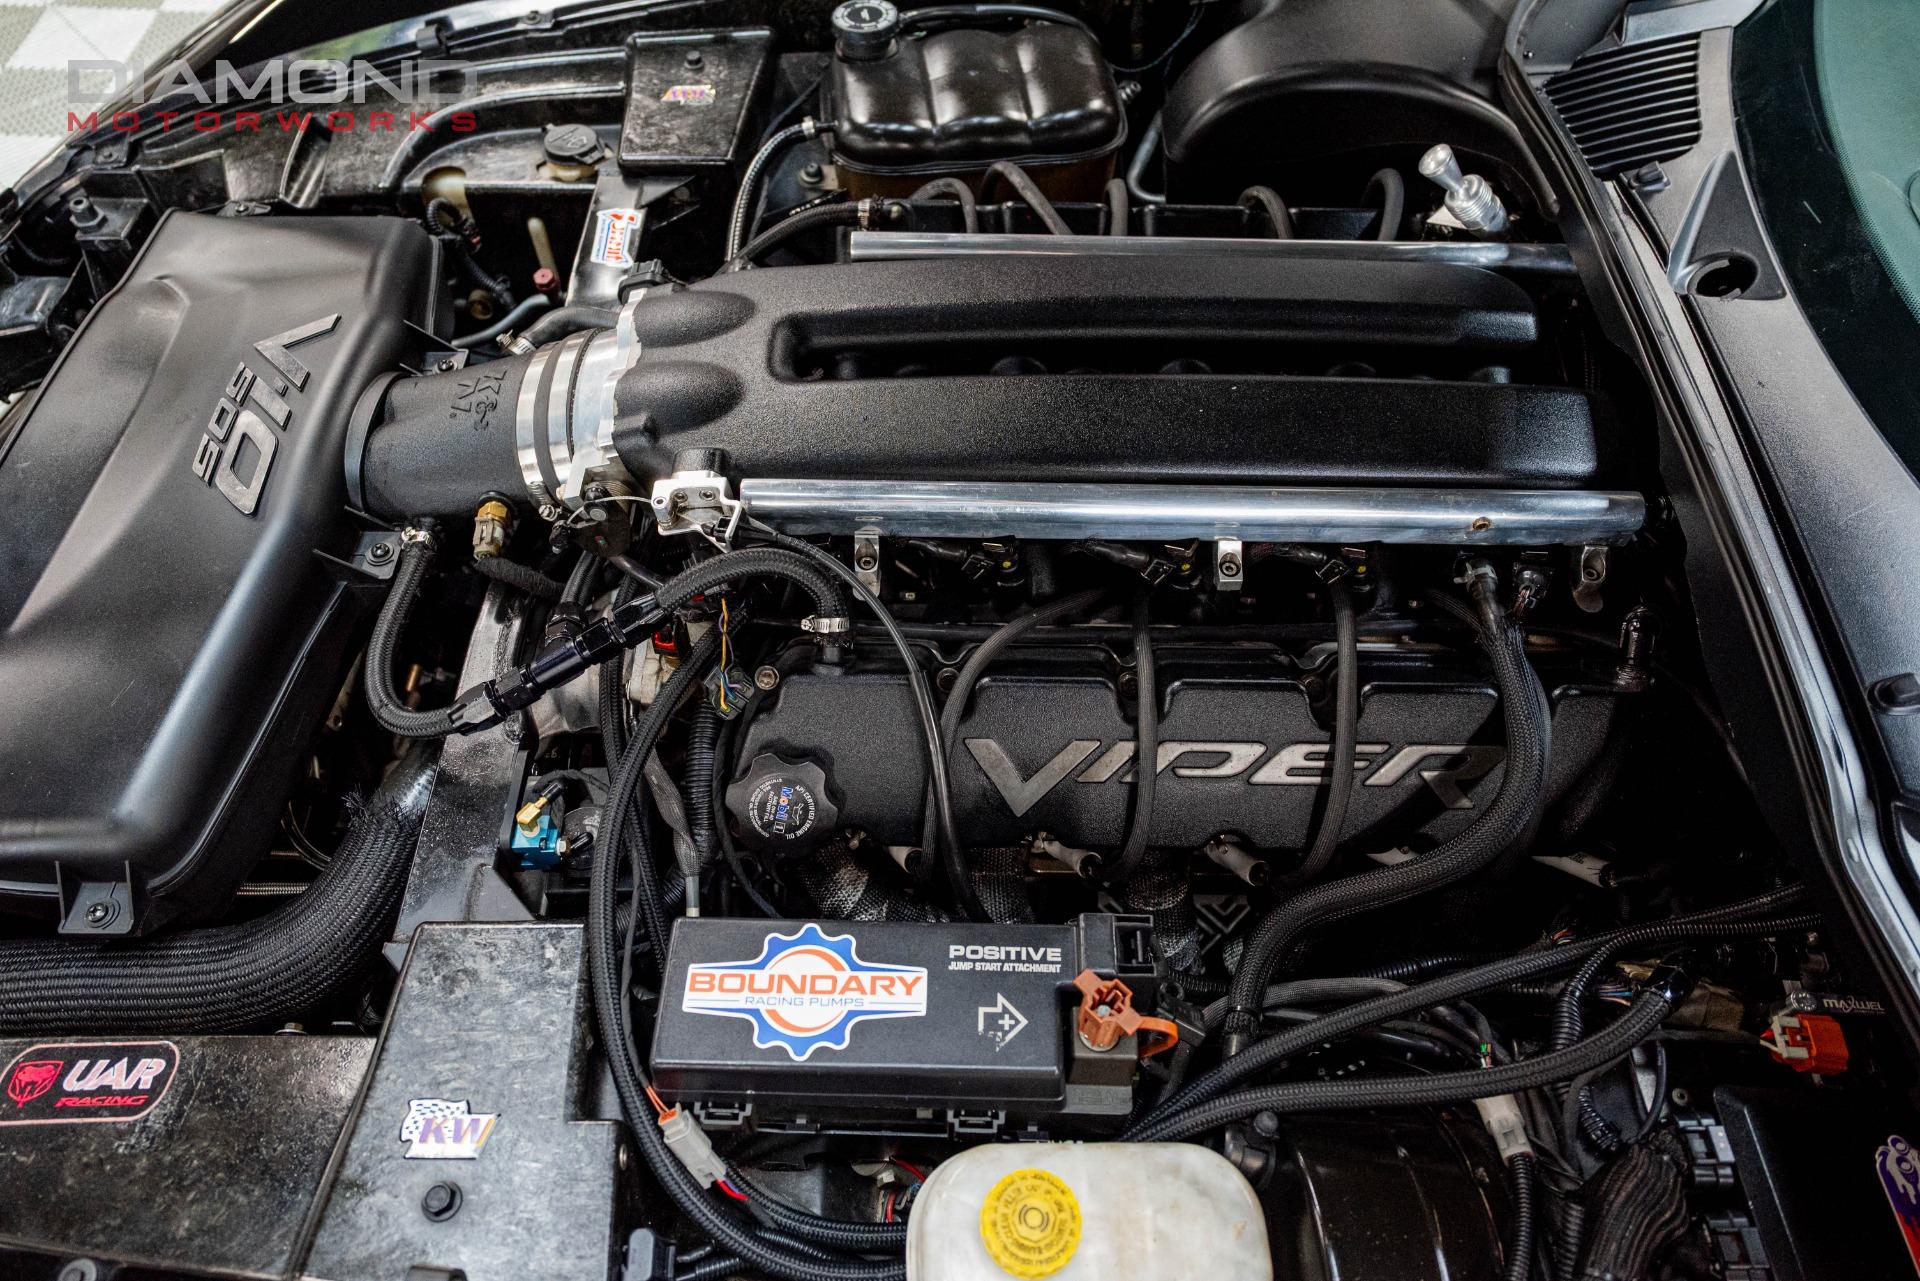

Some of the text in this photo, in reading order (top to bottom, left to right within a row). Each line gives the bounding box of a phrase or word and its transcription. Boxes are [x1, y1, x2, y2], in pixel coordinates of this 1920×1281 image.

[964, 738, 1507, 818] VIPER
[775, 786, 794, 821] Mobil
[803, 792, 815, 820] CERTIFIED
[796, 820, 813, 838] ENGINE
[949, 945, 1062, 962] POSITIVE
[948, 962, 1061, 973] JUMP START ATTACHMENT
[689, 972, 924, 997] BOUNDARY
[745, 996, 865, 1008] RACING PUMPS
[63, 1056, 167, 1092] UAR
[53, 1095, 149, 1108] RACING
[418, 1117, 490, 1145] KW
